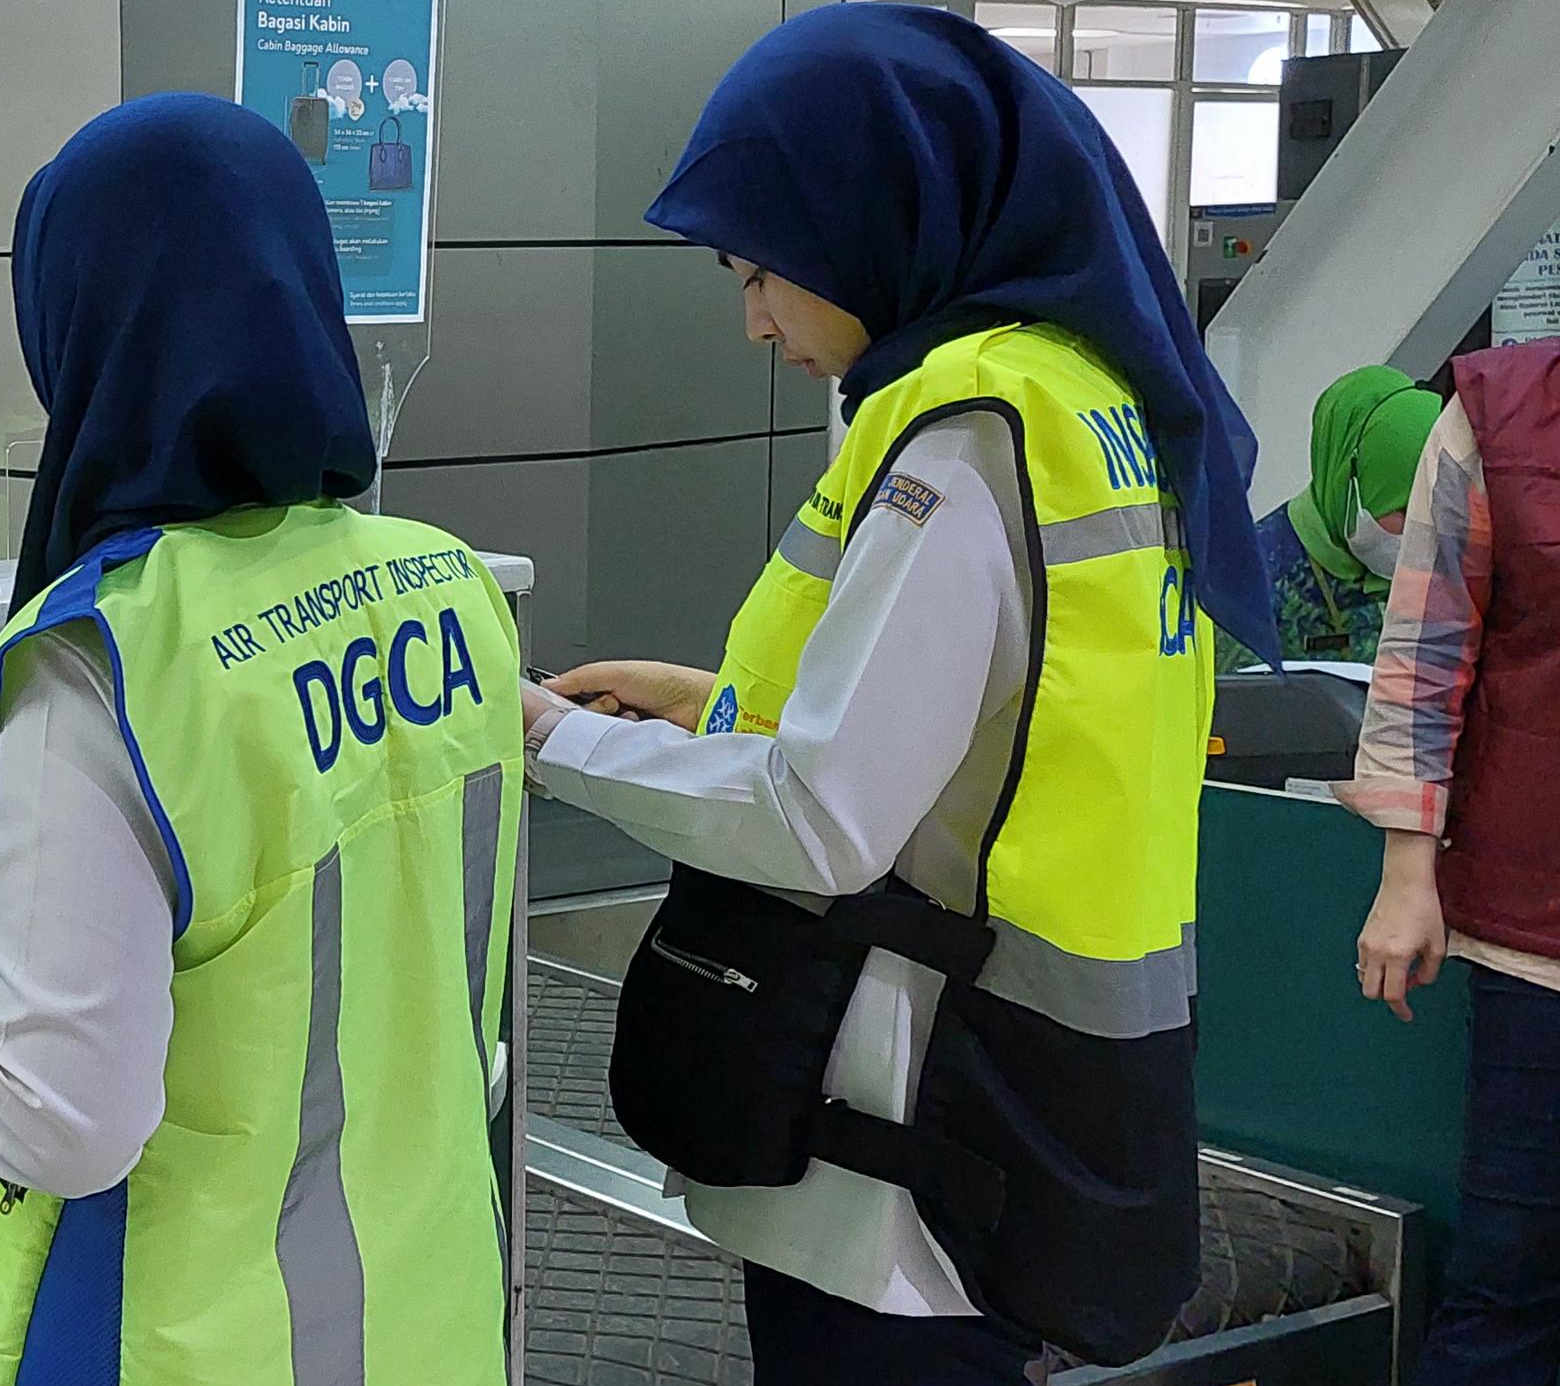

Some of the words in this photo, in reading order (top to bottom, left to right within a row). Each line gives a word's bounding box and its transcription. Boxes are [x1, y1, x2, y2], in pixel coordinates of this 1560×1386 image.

[257, 11, 306, 34] Bagasi
[309, 13, 351, 33] Kabin
[257, 38, 284, 51] Cabin
[284, 40, 324, 56] Baggage
[325, 42, 370, 56] Allowance
[892, 491, 925, 518] UDARA
[210, 623, 267, 671] AIR
[257, 564, 385, 644] TRANSPORT
[385, 548, 478, 597] INSPECTOR
[292, 607, 484, 774] DGCA
